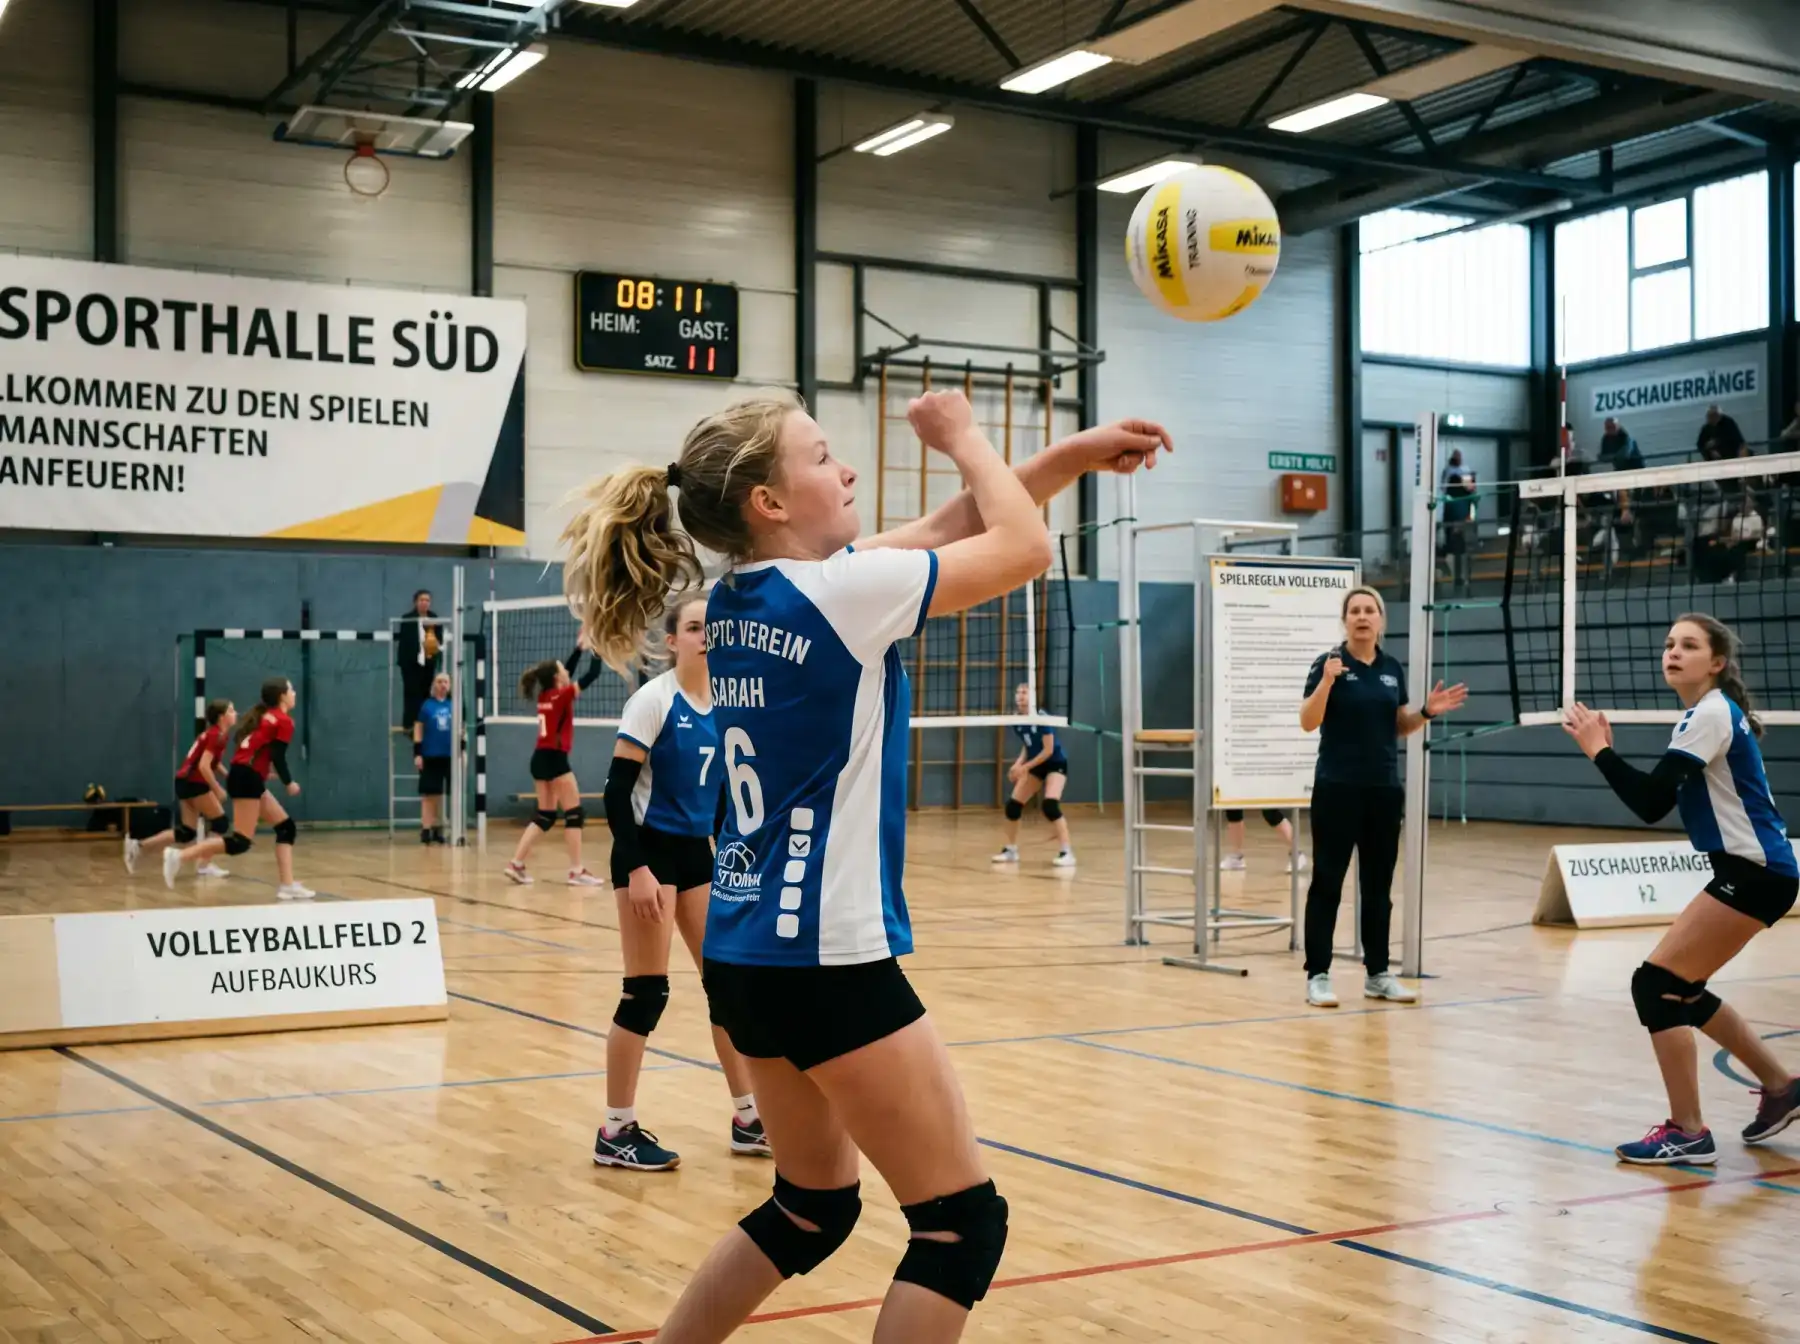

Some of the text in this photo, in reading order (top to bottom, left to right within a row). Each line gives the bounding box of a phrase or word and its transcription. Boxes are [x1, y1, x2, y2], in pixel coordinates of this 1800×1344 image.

[0, 286, 499, 373] SPORTHALLE SÜD
[591, 311, 729, 341] HEIM: GAST:
[0, 373, 429, 428] LKOMMEN ZU DEN SPIELEN
[1595, 369, 1756, 412] ZUSCHAUERRÄNGE
[0, 415, 268, 457] MANNSCHAFTEN
[0, 456, 185, 492] ANFEUERN!
[1220, 572, 1348, 589] SPIELREGELN VOLLEYBALL
[739, 619, 812, 665] VEREIN
[712, 677, 765, 708] SARAH
[699, 746, 716, 786] 7
[724, 727, 765, 836] 6
[1569, 851, 1713, 877] ZUSCHAUERRÄNGE
[147, 920, 427, 958] VOLLEYBALLFELD 2
[211, 963, 377, 994] AUFBAUKURS
